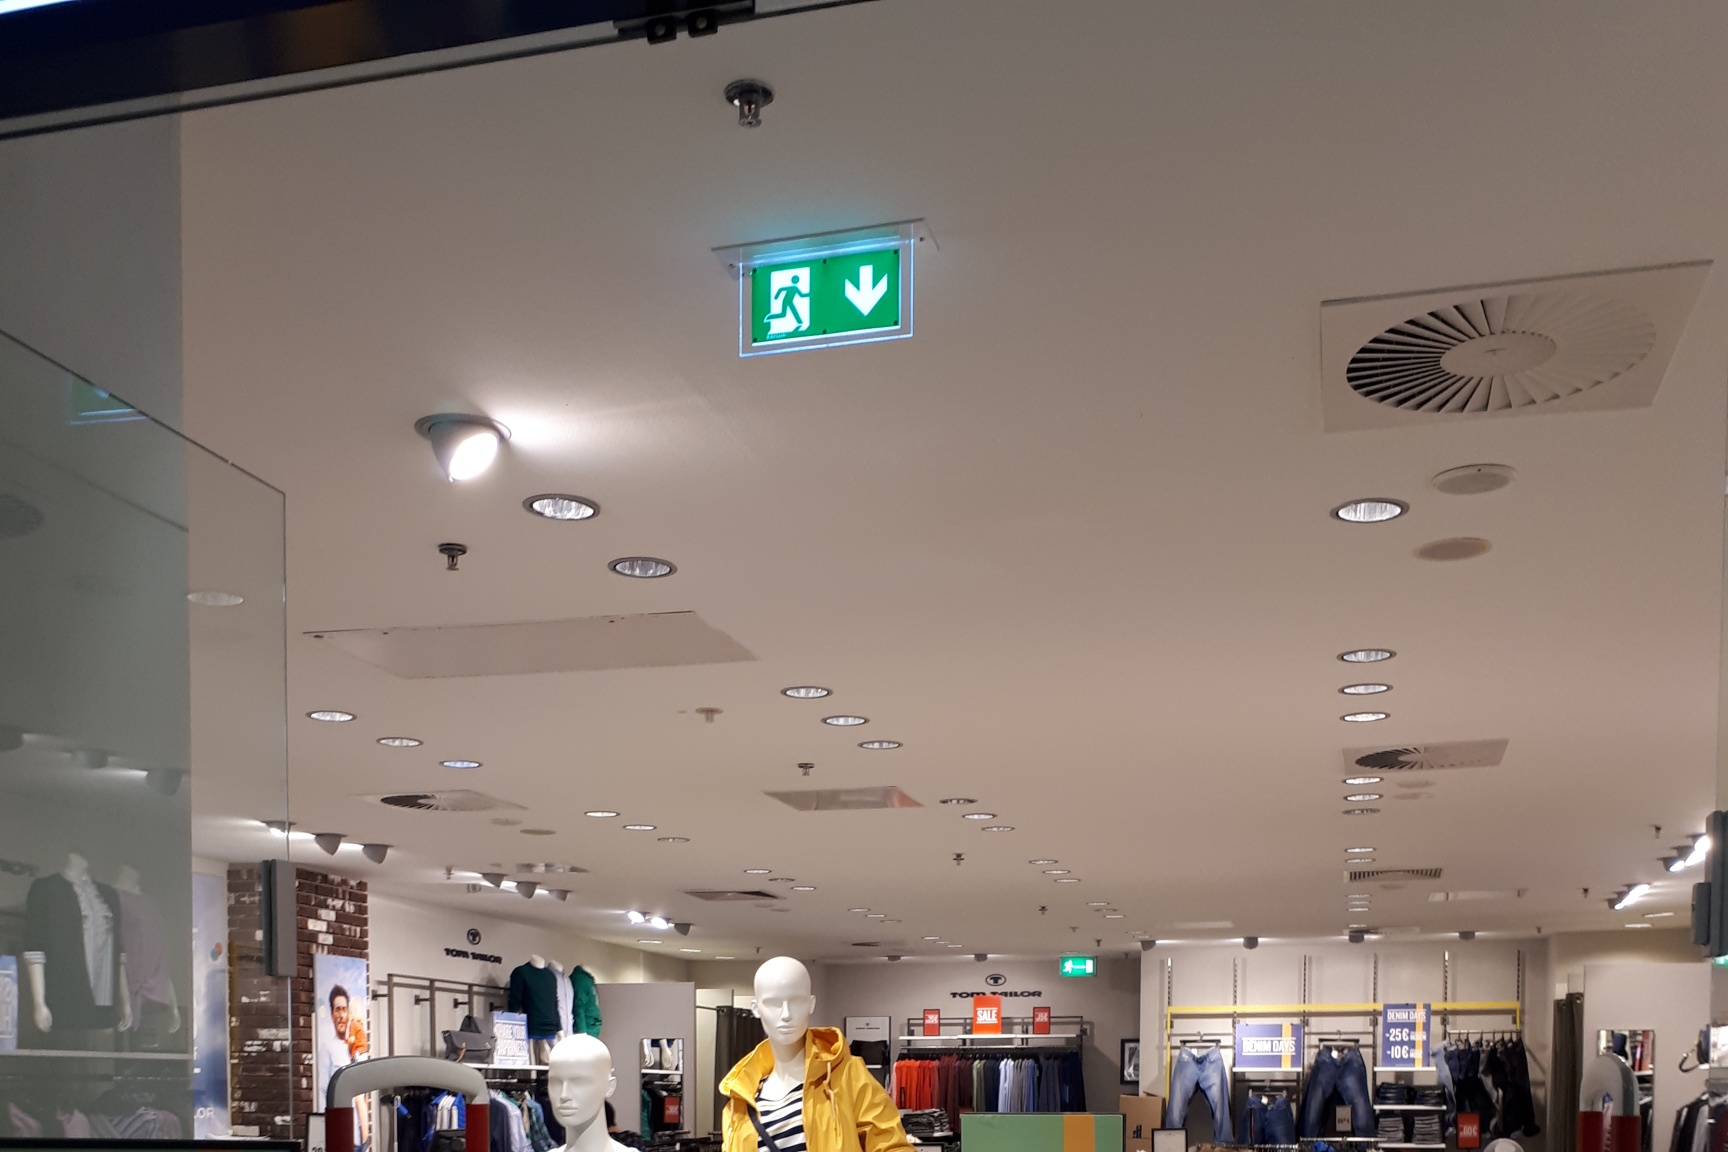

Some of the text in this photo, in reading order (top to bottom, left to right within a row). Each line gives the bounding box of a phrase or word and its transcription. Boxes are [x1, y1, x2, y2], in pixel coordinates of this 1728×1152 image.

[977, 1009, 998, 1021] SALE
[1387, 1011, 1426, 1020] DENIM DAYS
[1242, 1039, 1296, 1053] DENIM DAYS
